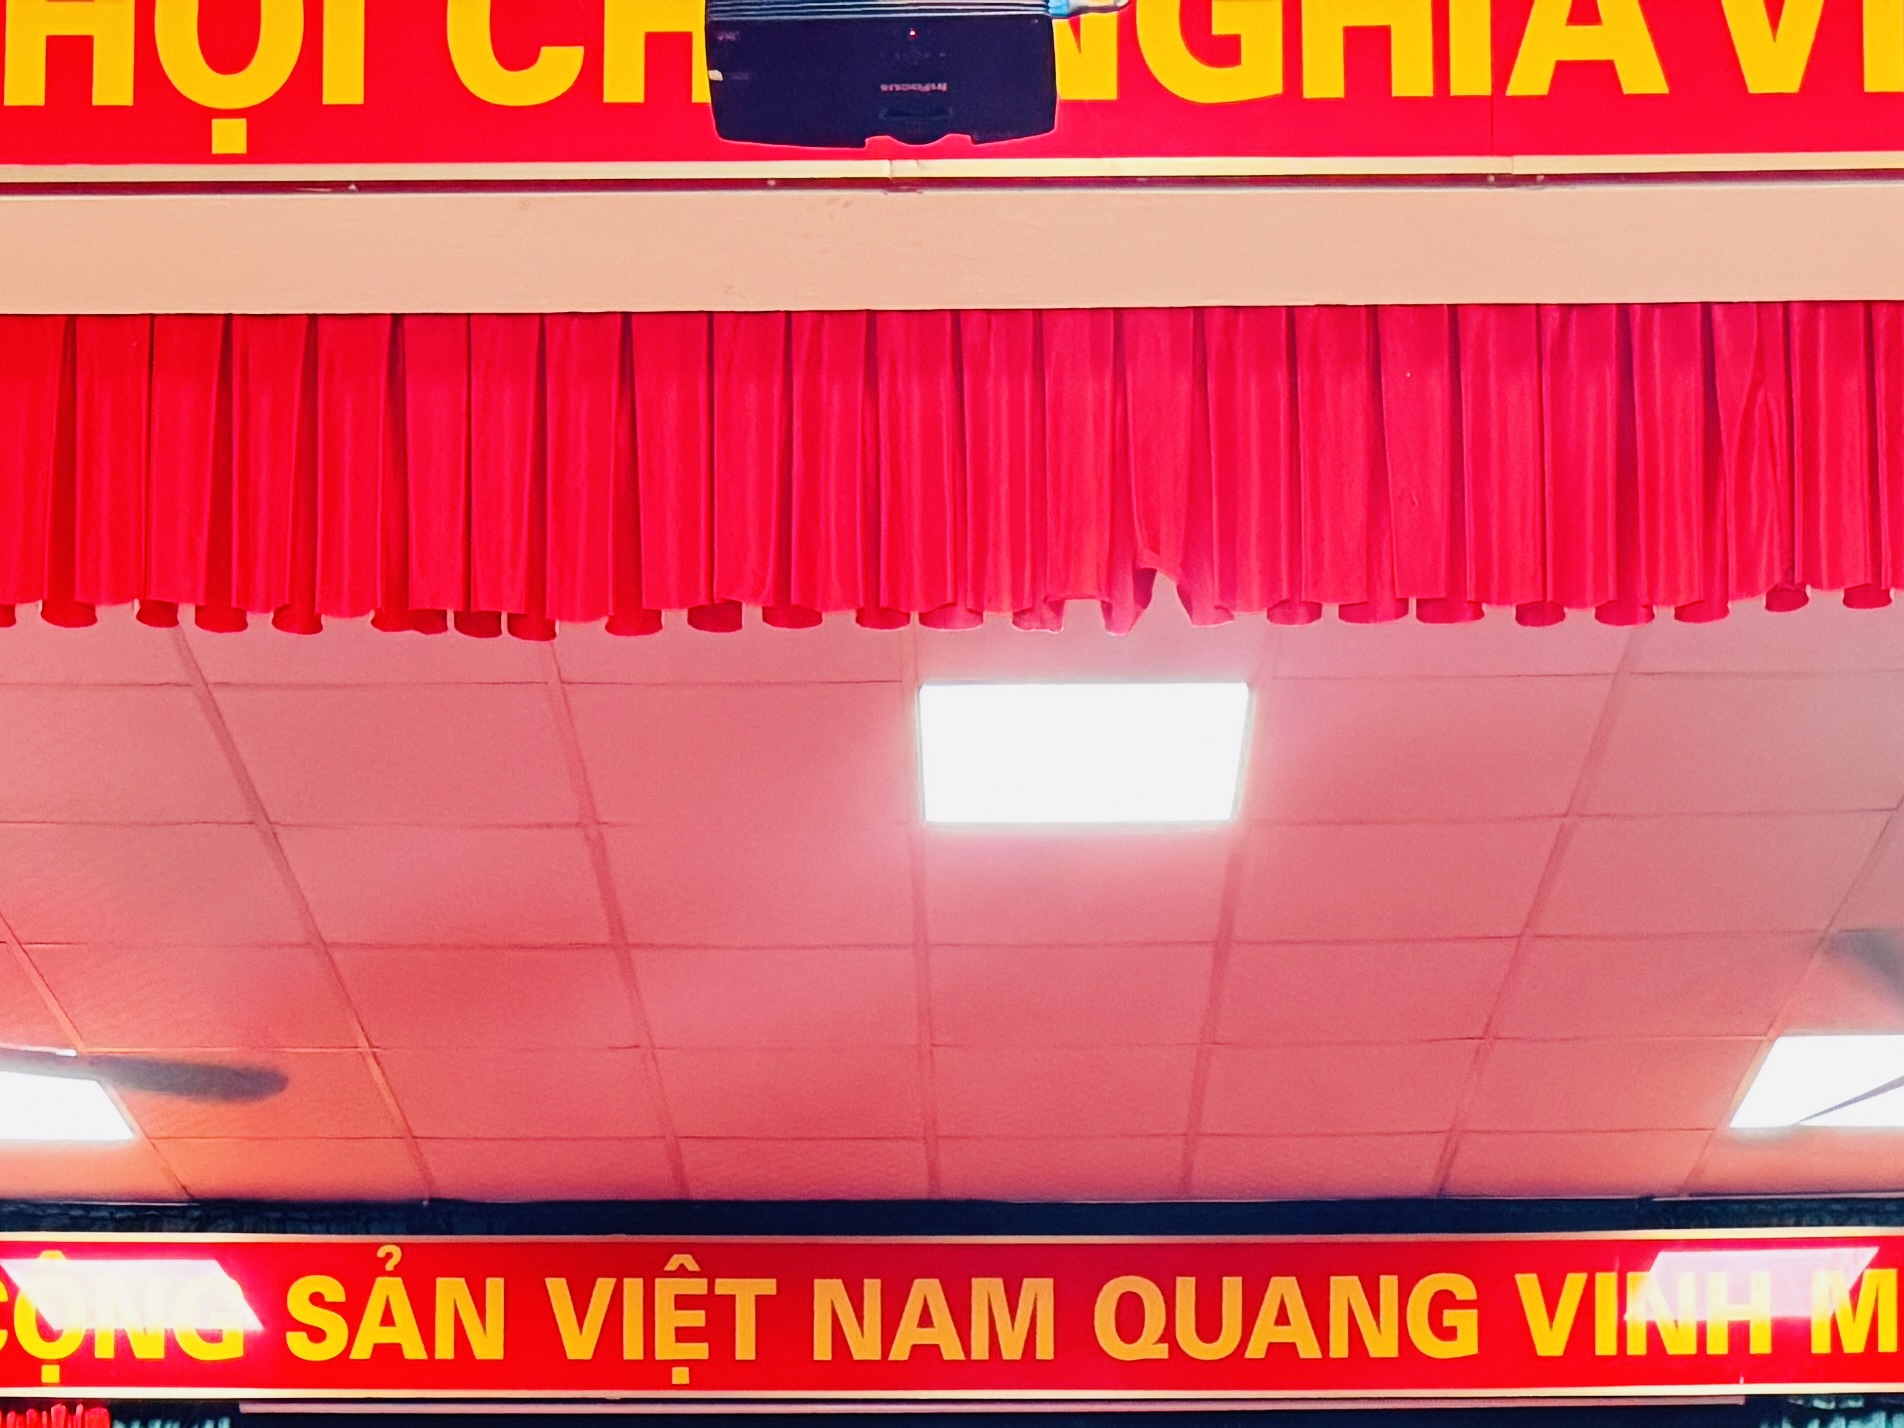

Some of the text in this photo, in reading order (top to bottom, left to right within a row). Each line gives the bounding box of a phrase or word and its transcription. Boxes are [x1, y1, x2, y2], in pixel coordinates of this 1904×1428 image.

[285, 1244, 504, 1361] SẢN
[546, 1253, 777, 1385] VIỆT
[812, 1278, 1056, 1362] NAM
[1094, 1273, 1478, 1361] QUANG
[1515, 1271, 1773, 1358] VINH
